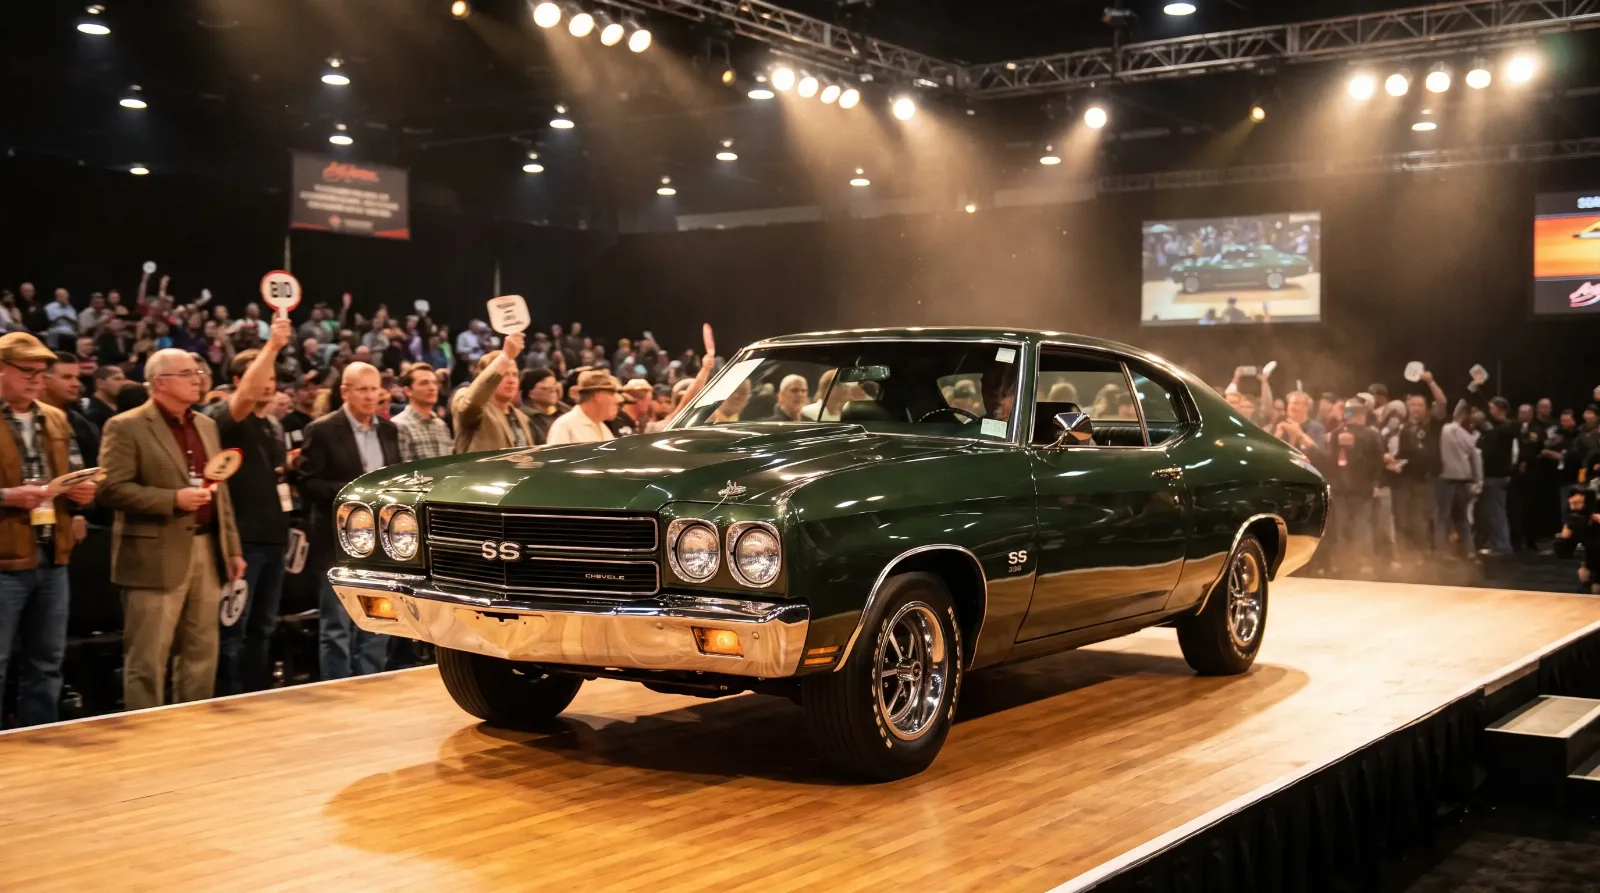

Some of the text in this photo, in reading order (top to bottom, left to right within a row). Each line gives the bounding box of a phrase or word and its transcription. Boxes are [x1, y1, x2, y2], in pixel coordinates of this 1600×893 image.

[270, 281, 293, 299] BID
[481, 541, 520, 560] SS
[1008, 550, 1028, 565] SS
